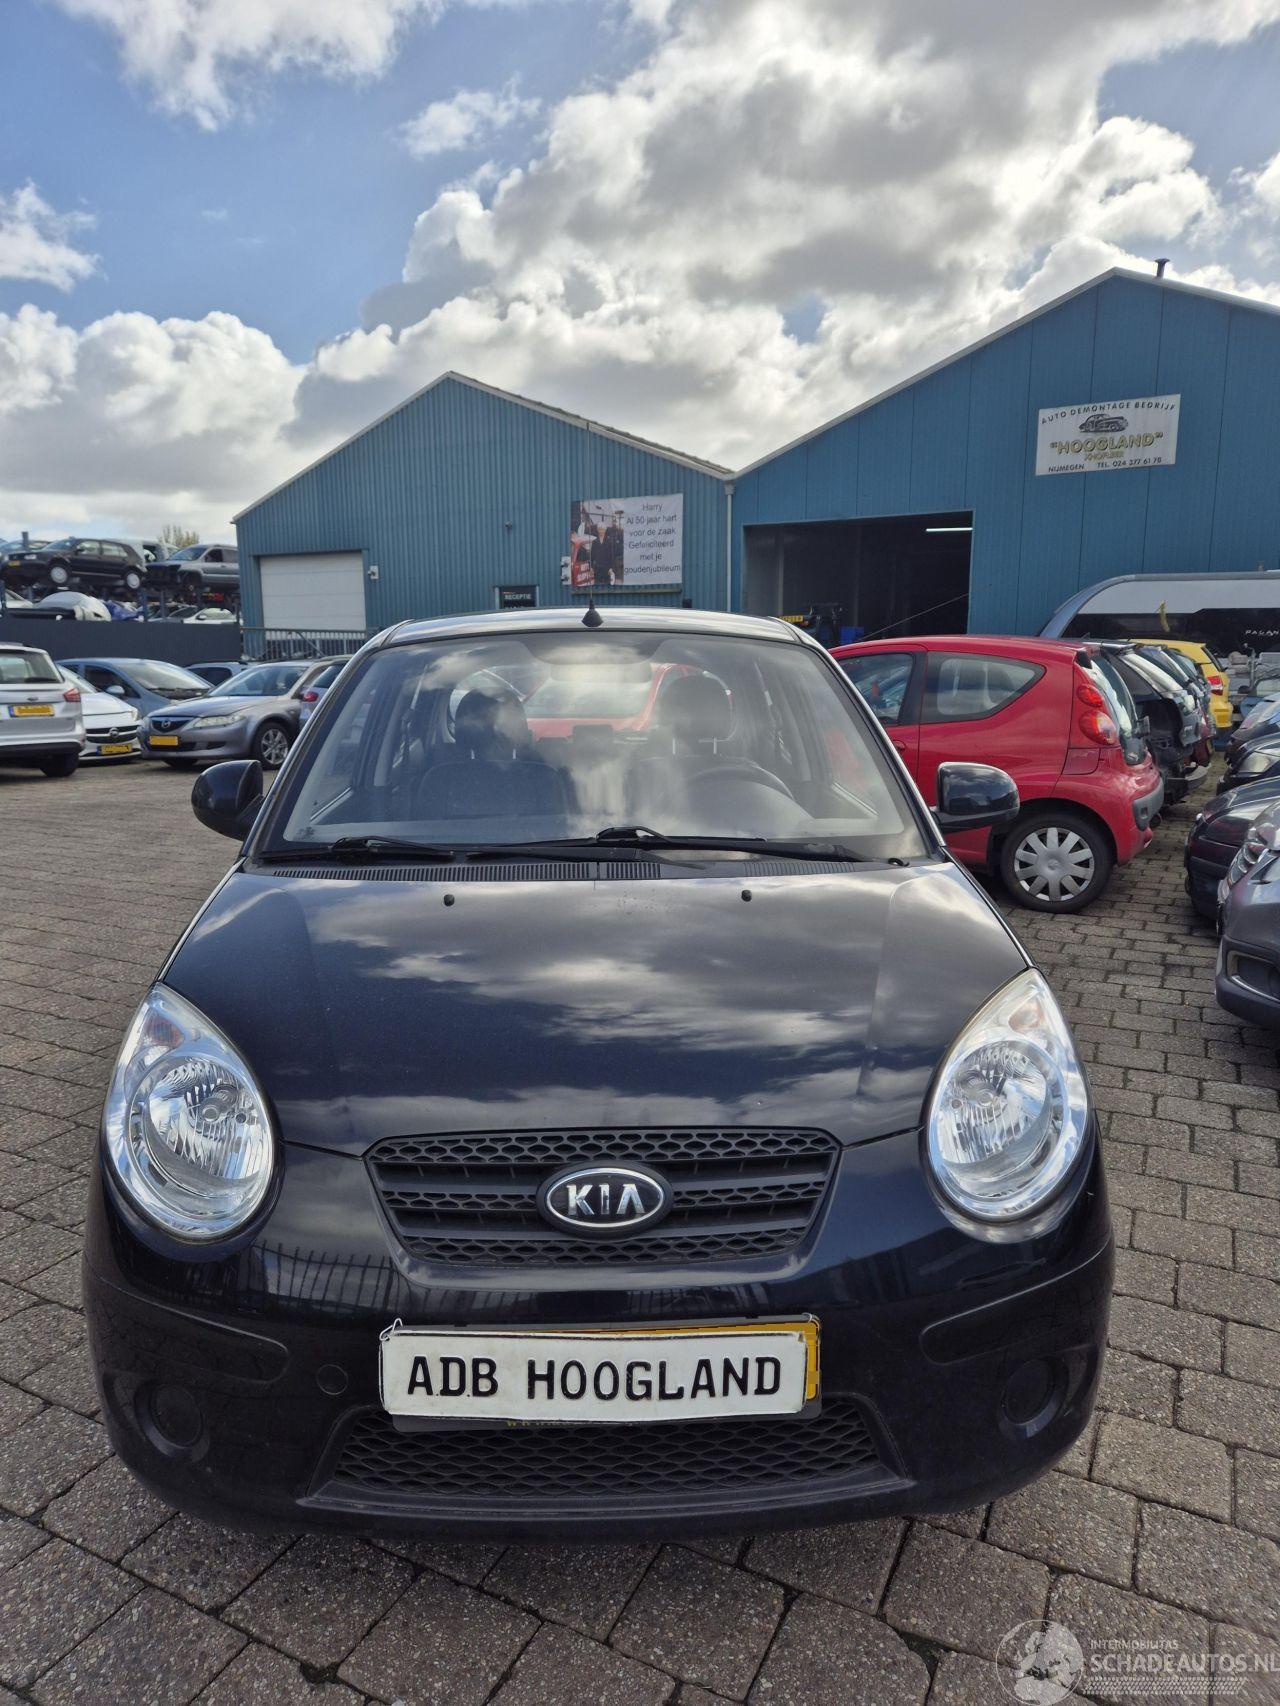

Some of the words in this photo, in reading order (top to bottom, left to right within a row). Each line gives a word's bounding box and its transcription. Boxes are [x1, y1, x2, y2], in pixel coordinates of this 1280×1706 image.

[1041, 411, 1067, 425] AUTO
[1070, 402, 1132, 416] DEMONTAGE
[1134, 401, 1176, 411] BEDRIJF
[1048, 463, 1085, 473] NIJMEGEN
[1112, 459, 1127, 468] 024
[642, 503, 664, 512] Harry
[635, 516, 645, 525] 50
[646, 517, 660, 525] jaar
[628, 541, 675, 549] Gefeliciteerd
[655, 553, 663, 562] je
[566, 1183, 646, 1215] KIA
[527, 1356, 781, 1401] HOOGLAND
